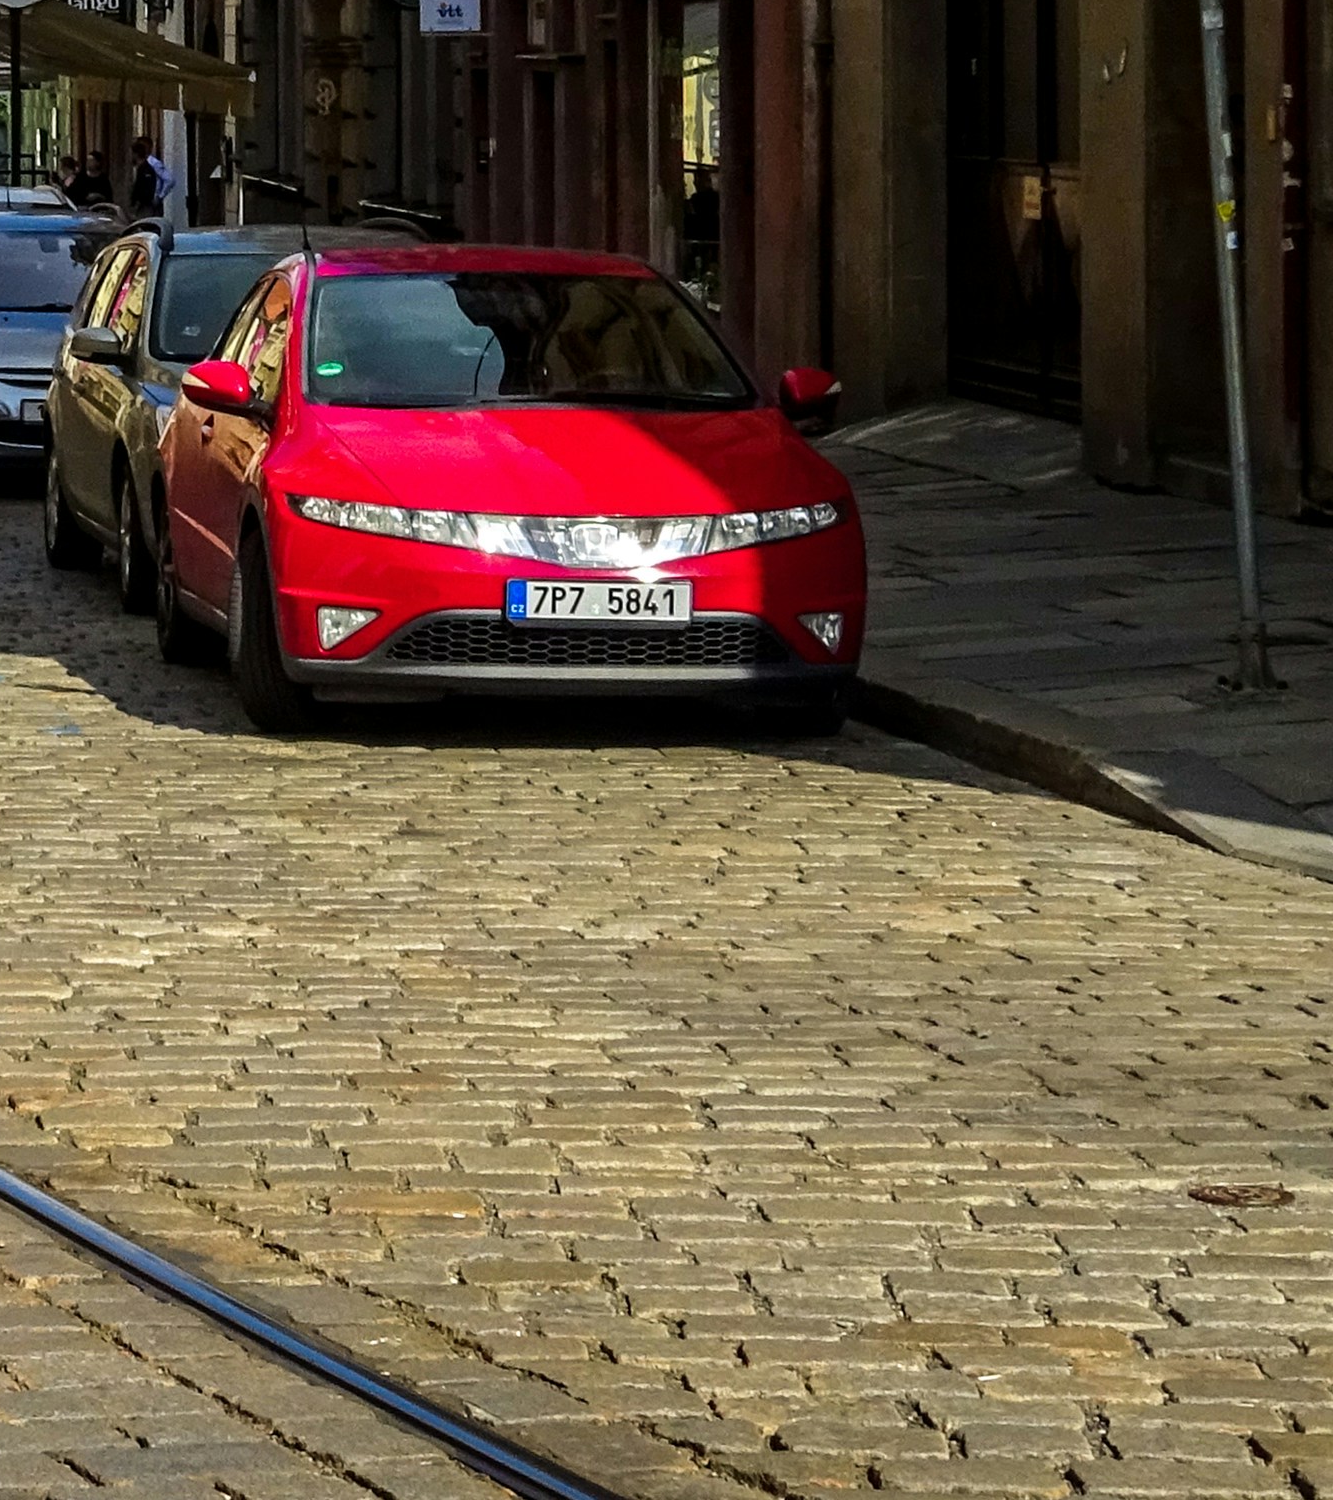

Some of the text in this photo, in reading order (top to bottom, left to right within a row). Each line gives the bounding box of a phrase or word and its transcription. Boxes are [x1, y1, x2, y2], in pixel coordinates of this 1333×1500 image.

[510, 604, 525, 613] CZ
[533, 586, 675, 616] 7P7 5841
